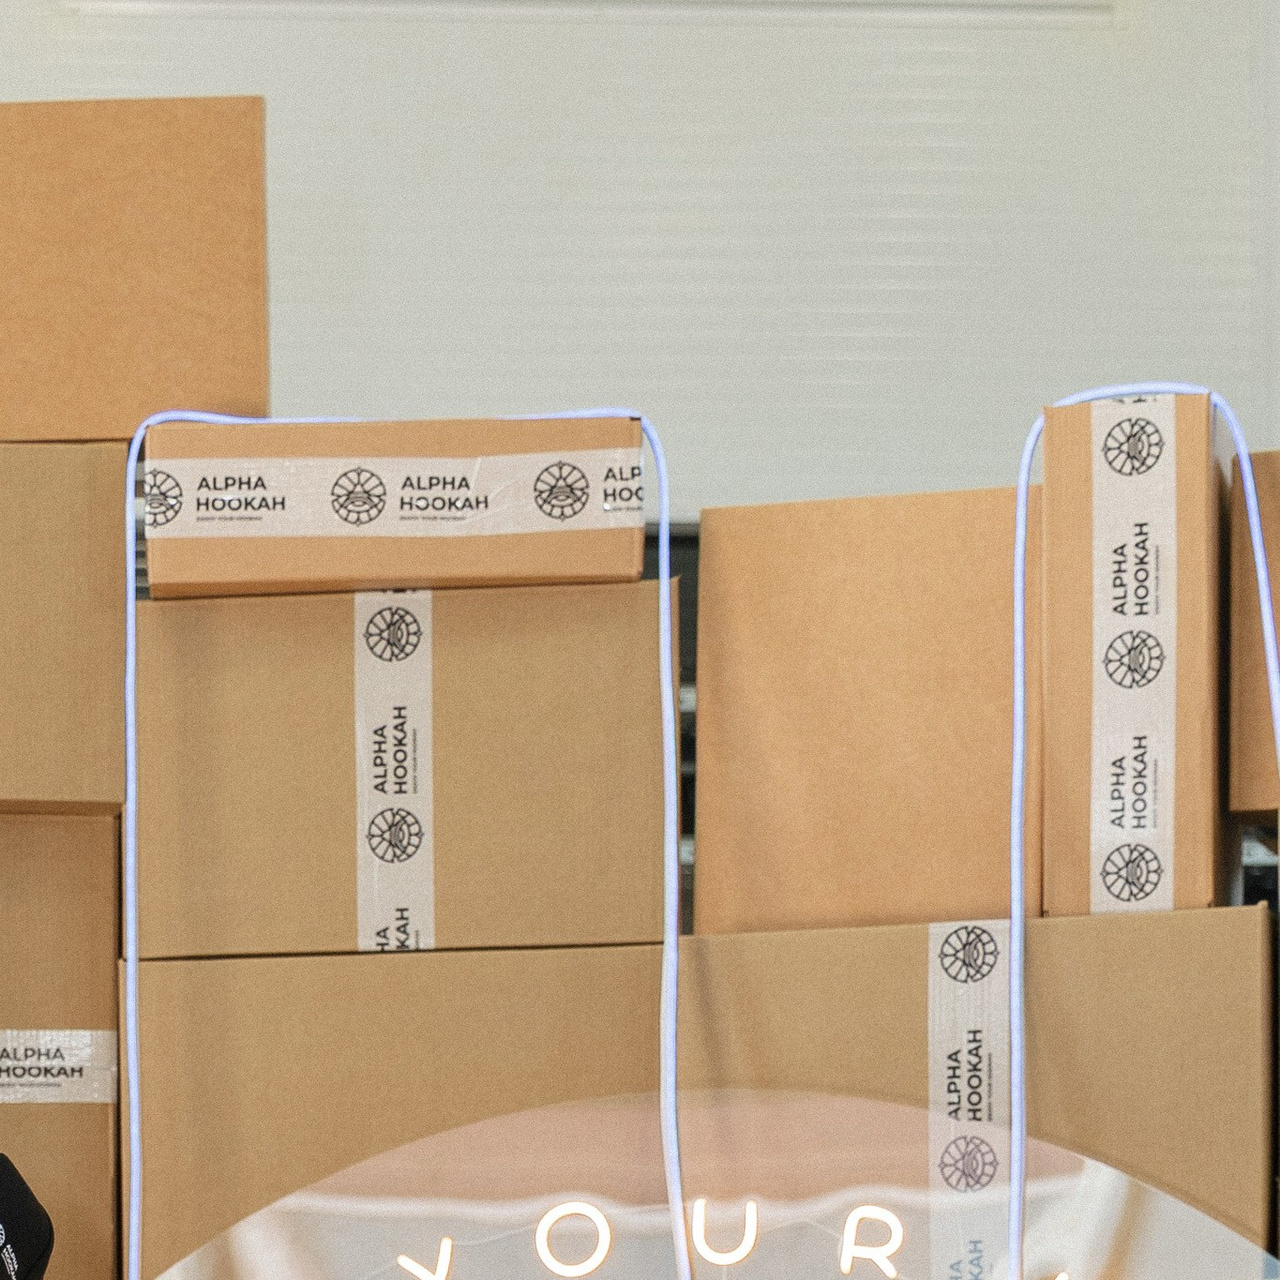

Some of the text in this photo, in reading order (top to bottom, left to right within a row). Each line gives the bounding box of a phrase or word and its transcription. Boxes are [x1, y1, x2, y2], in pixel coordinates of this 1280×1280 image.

[196, 496, 286, 512] HOOKAH
[197, 476, 267, 491] ALPHA
[400, 496, 489, 511] HOOKAH
[401, 476, 471, 491] ALPHA
[1112, 543, 1127, 616] ALPHA
[1134, 522, 1149, 616] HOOKAH
[373, 725, 387, 795] ALPHA
[393, 706, 408, 795] HOOKAH
[1132, 735, 1147, 829] HOOKAH
[1110, 757, 1125, 829] ALPHA
[947, 1049, 961, 1121] ALPHA
[967, 1029, 982, 1122] HOOKAH
[6, 1244, 18, 1271] ALPHA
